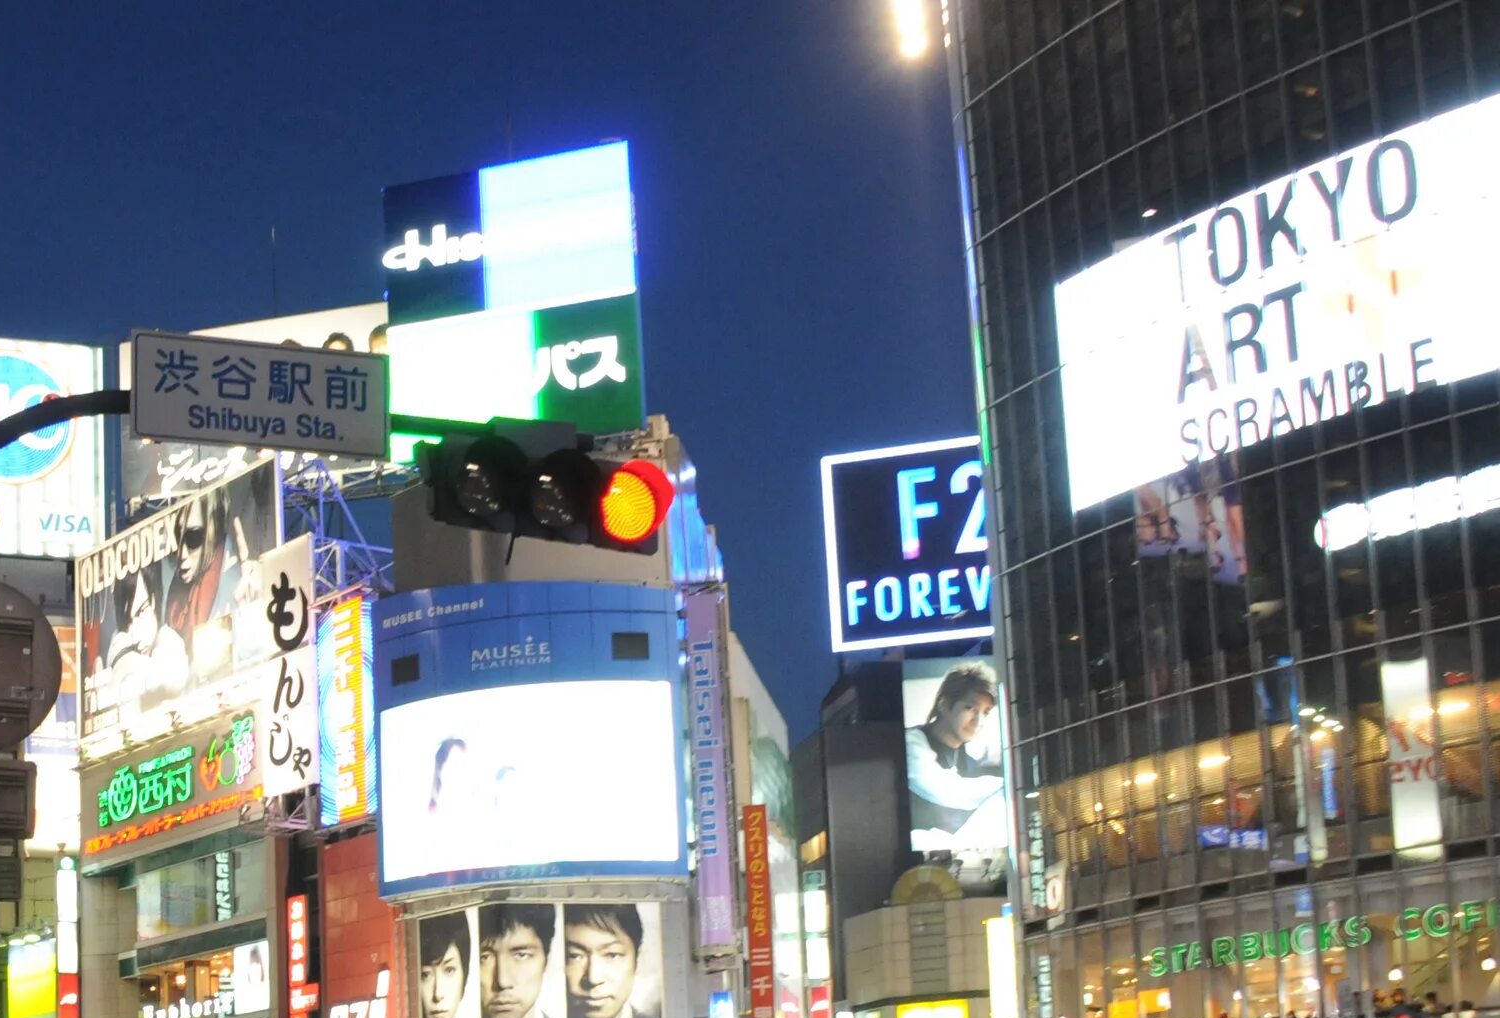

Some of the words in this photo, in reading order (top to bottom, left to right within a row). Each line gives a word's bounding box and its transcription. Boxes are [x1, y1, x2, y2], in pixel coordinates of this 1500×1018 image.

[1162, 137, 1418, 302] TOKYO
[1177, 281, 1307, 404] ART
[154, 348, 368, 412] 渋谷駅前
[1180, 338, 1434, 464] SCRAMBLE
[188, 404, 286, 439] Shibuya
[296, 413, 345, 442] Sta.
[39, 512, 92, 533] VISA
[80, 511, 178, 598] OLDCODEX
[428, 598, 484, 618] Channel
[471, 656, 551, 671] PLATINUM
[139, 763, 192, 815] 西村
[1149, 915, 1373, 978] STARBUCKS
